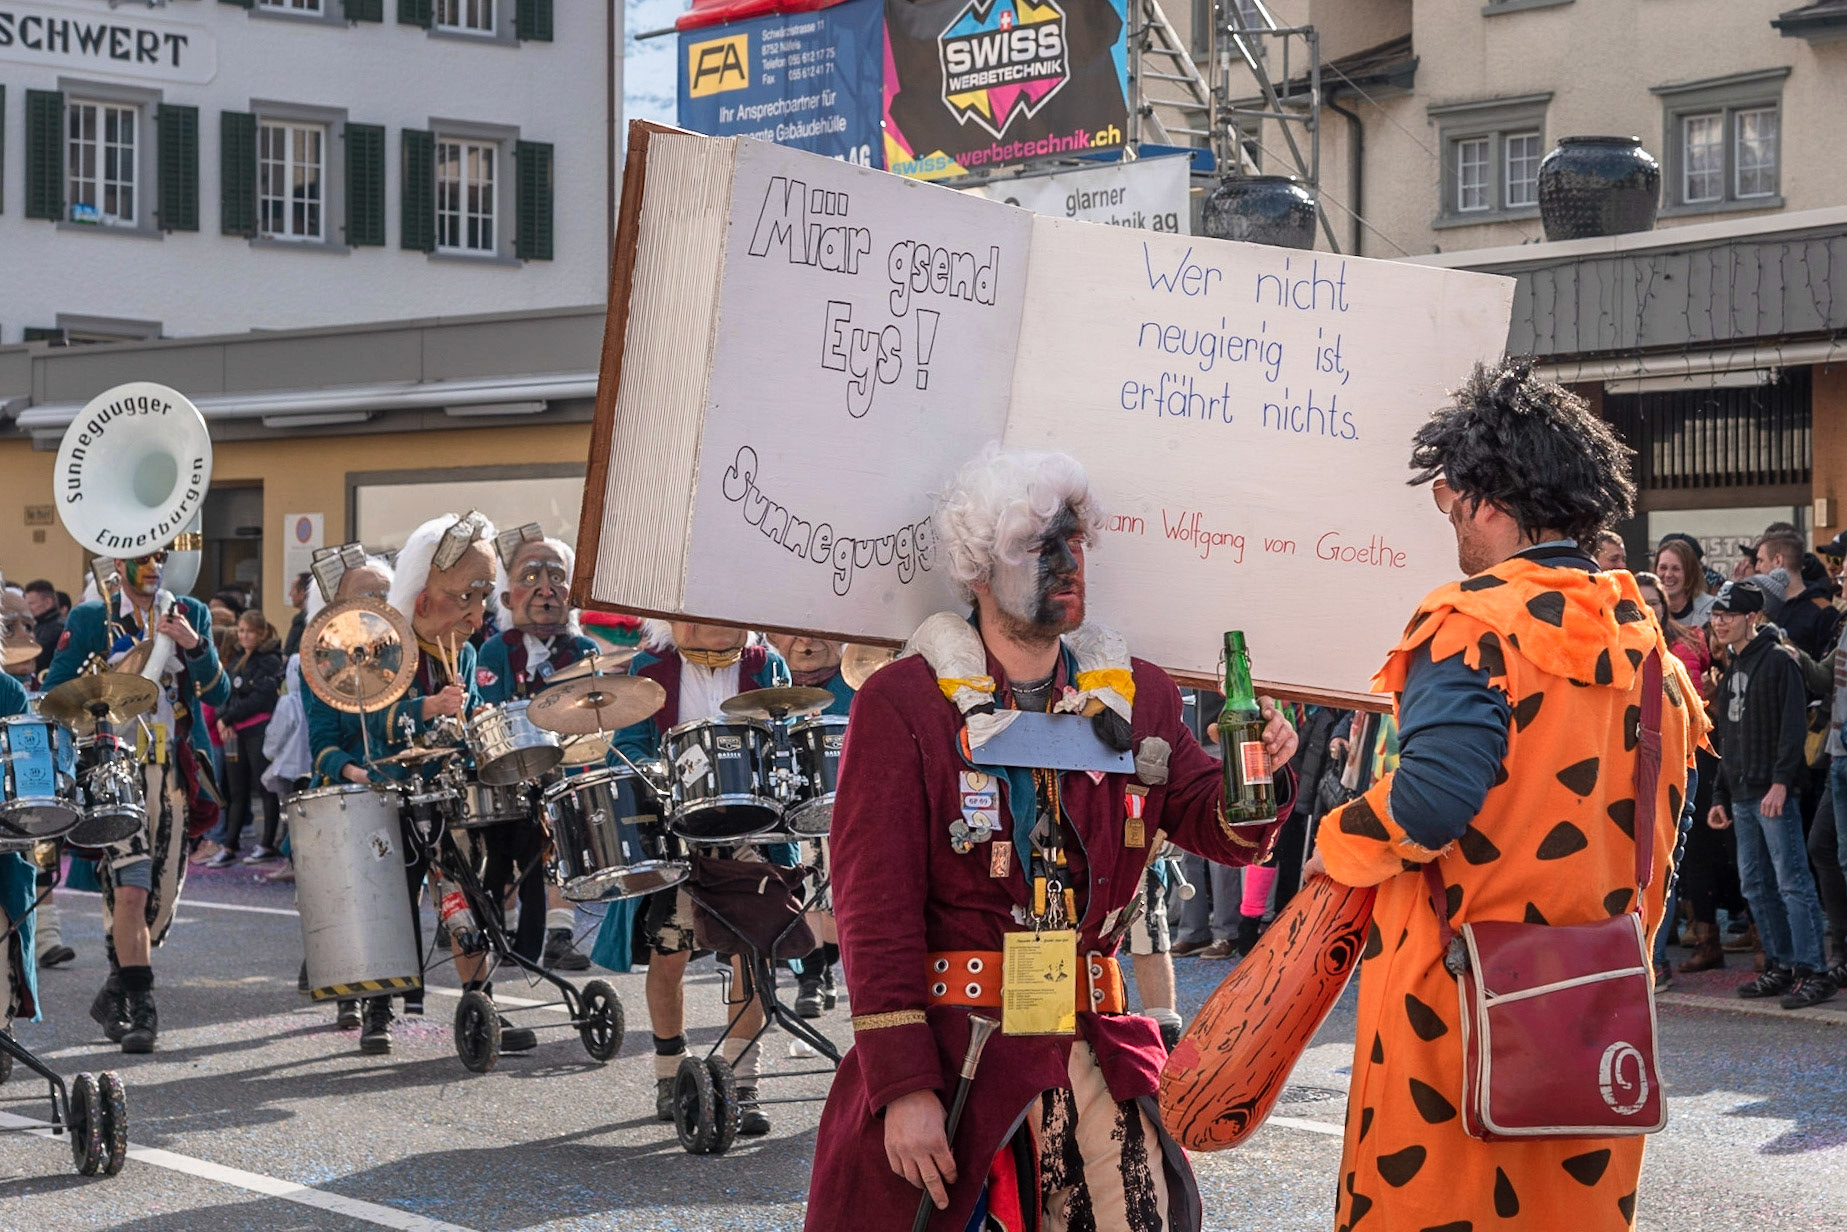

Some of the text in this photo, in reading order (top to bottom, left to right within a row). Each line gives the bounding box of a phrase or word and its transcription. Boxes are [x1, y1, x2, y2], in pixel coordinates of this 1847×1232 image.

[0, 12, 188, 68] SCHWERT
[693, 43, 746, 90] FA
[945, 24, 1061, 74] SWISS
[762, 73, 776, 85] Fax
[948, 58, 1063, 92] WERBETECHNIK
[719, 88, 837, 123] Ihr Ansprechpartner für
[776, 114, 847, 142] Gebäudehülle
[891, 123, 1121, 176] swiss-werbetechnik.ch
[1065, 186, 1127, 218] glarner
[748, 176, 1000, 318] Miär gsend
[1143, 241, 1349, 313] Wer nicht
[1138, 316, 1350, 386] neugierig ist,
[1121, 371, 1360, 441] erfährt nichts.
[67, 395, 172, 503] Sunneguugger
[95, 457, 203, 549] Ennetbürgen
[722, 445, 934, 597] Sunneguugg
[1162, 508, 1246, 564] Wolfgang
[1264, 536, 1296, 555] von
[1316, 531, 1407, 569] Goethe
